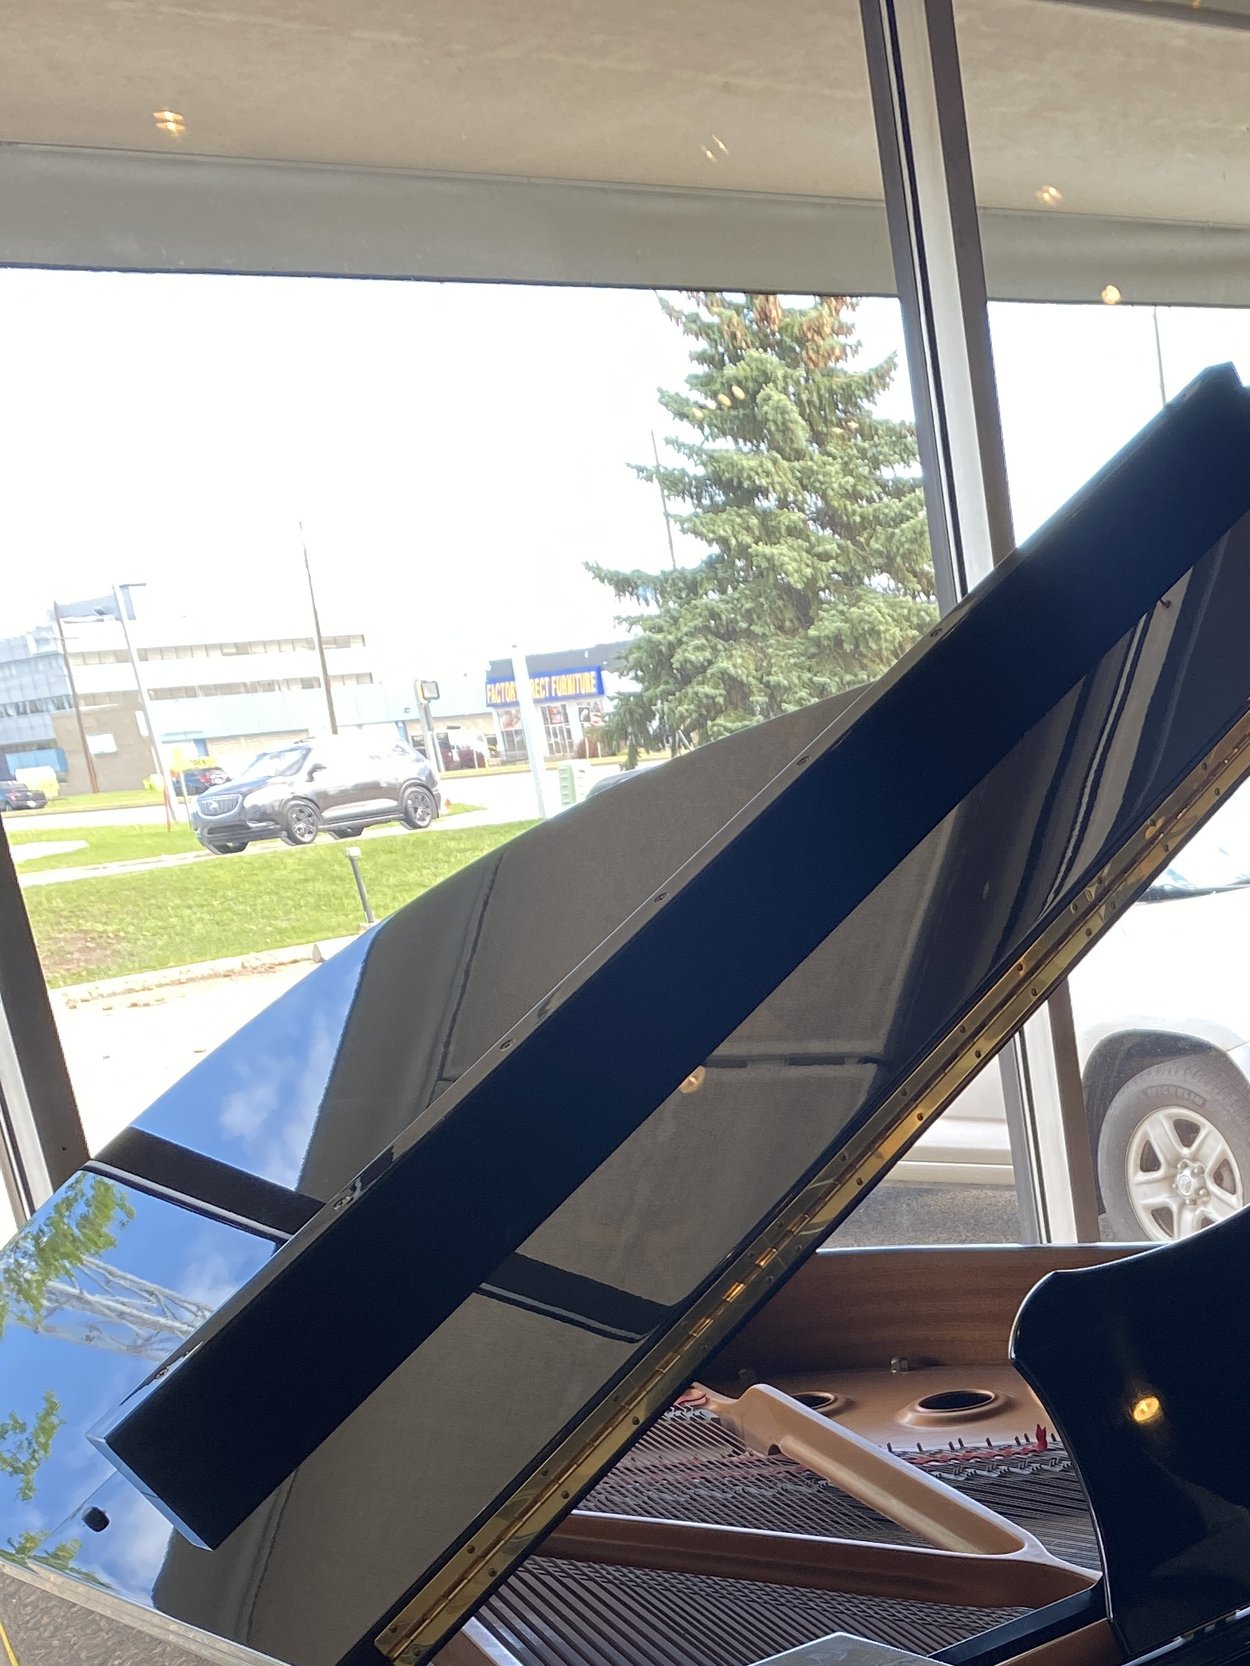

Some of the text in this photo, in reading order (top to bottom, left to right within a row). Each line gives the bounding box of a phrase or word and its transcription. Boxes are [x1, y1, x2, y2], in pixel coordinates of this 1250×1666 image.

[486, 671, 597, 704] FACTOR RECT FURNITURE
